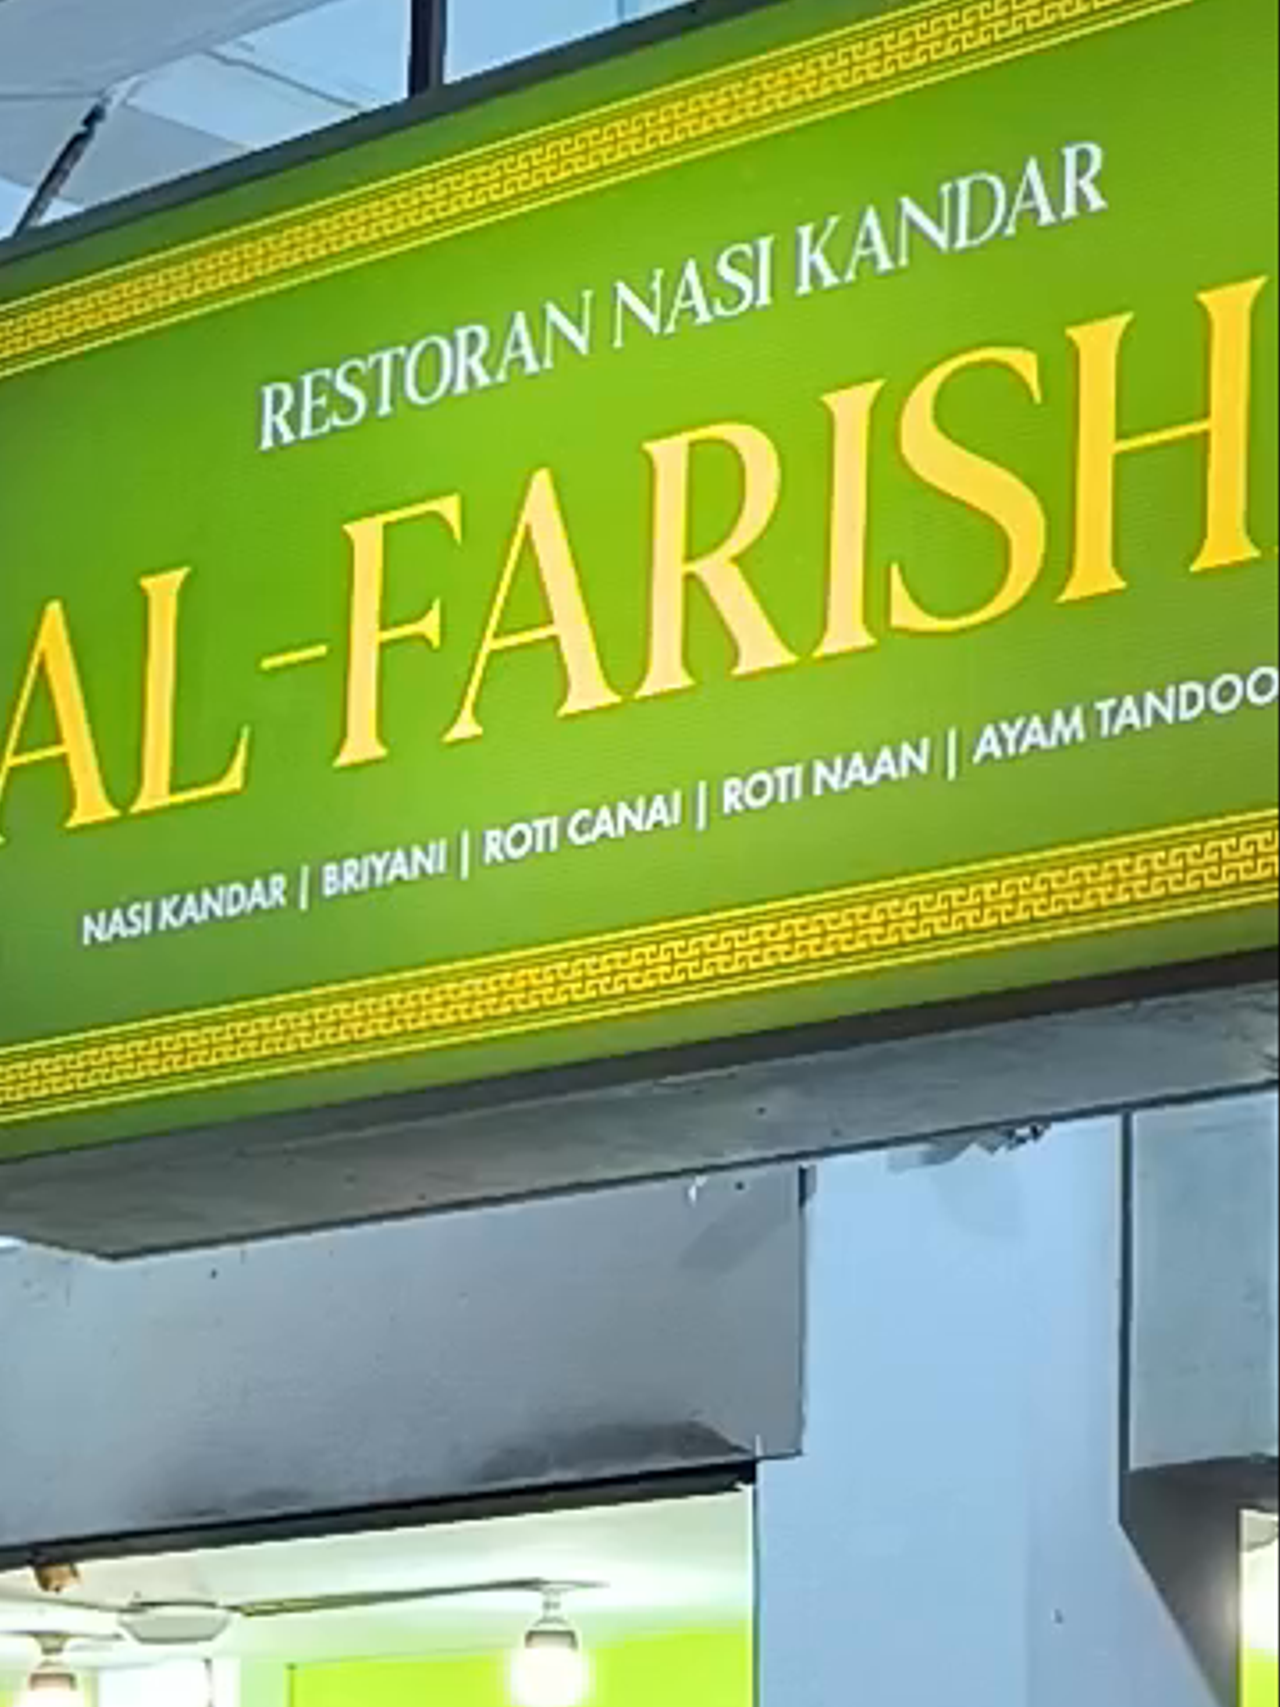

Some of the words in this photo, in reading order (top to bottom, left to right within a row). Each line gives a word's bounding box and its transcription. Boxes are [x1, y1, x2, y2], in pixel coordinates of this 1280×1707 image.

[256, 291, 594, 451] RESTORAN
[613, 235, 777, 349] NASI
[795, 140, 1109, 296] KANDAR
[81, 901, 152, 946] NASI
[158, 874, 286, 932] KANDAR
[320, 840, 448, 899] BRIYANI
[482, 815, 558, 864] ROTI
[567, 790, 683, 847] CANAI
[721, 761, 804, 815] ROTI
[812, 737, 931, 797] NAAN
[972, 704, 1086, 765] AYAM
[1093, 665, 1278, 740] TANDOO
